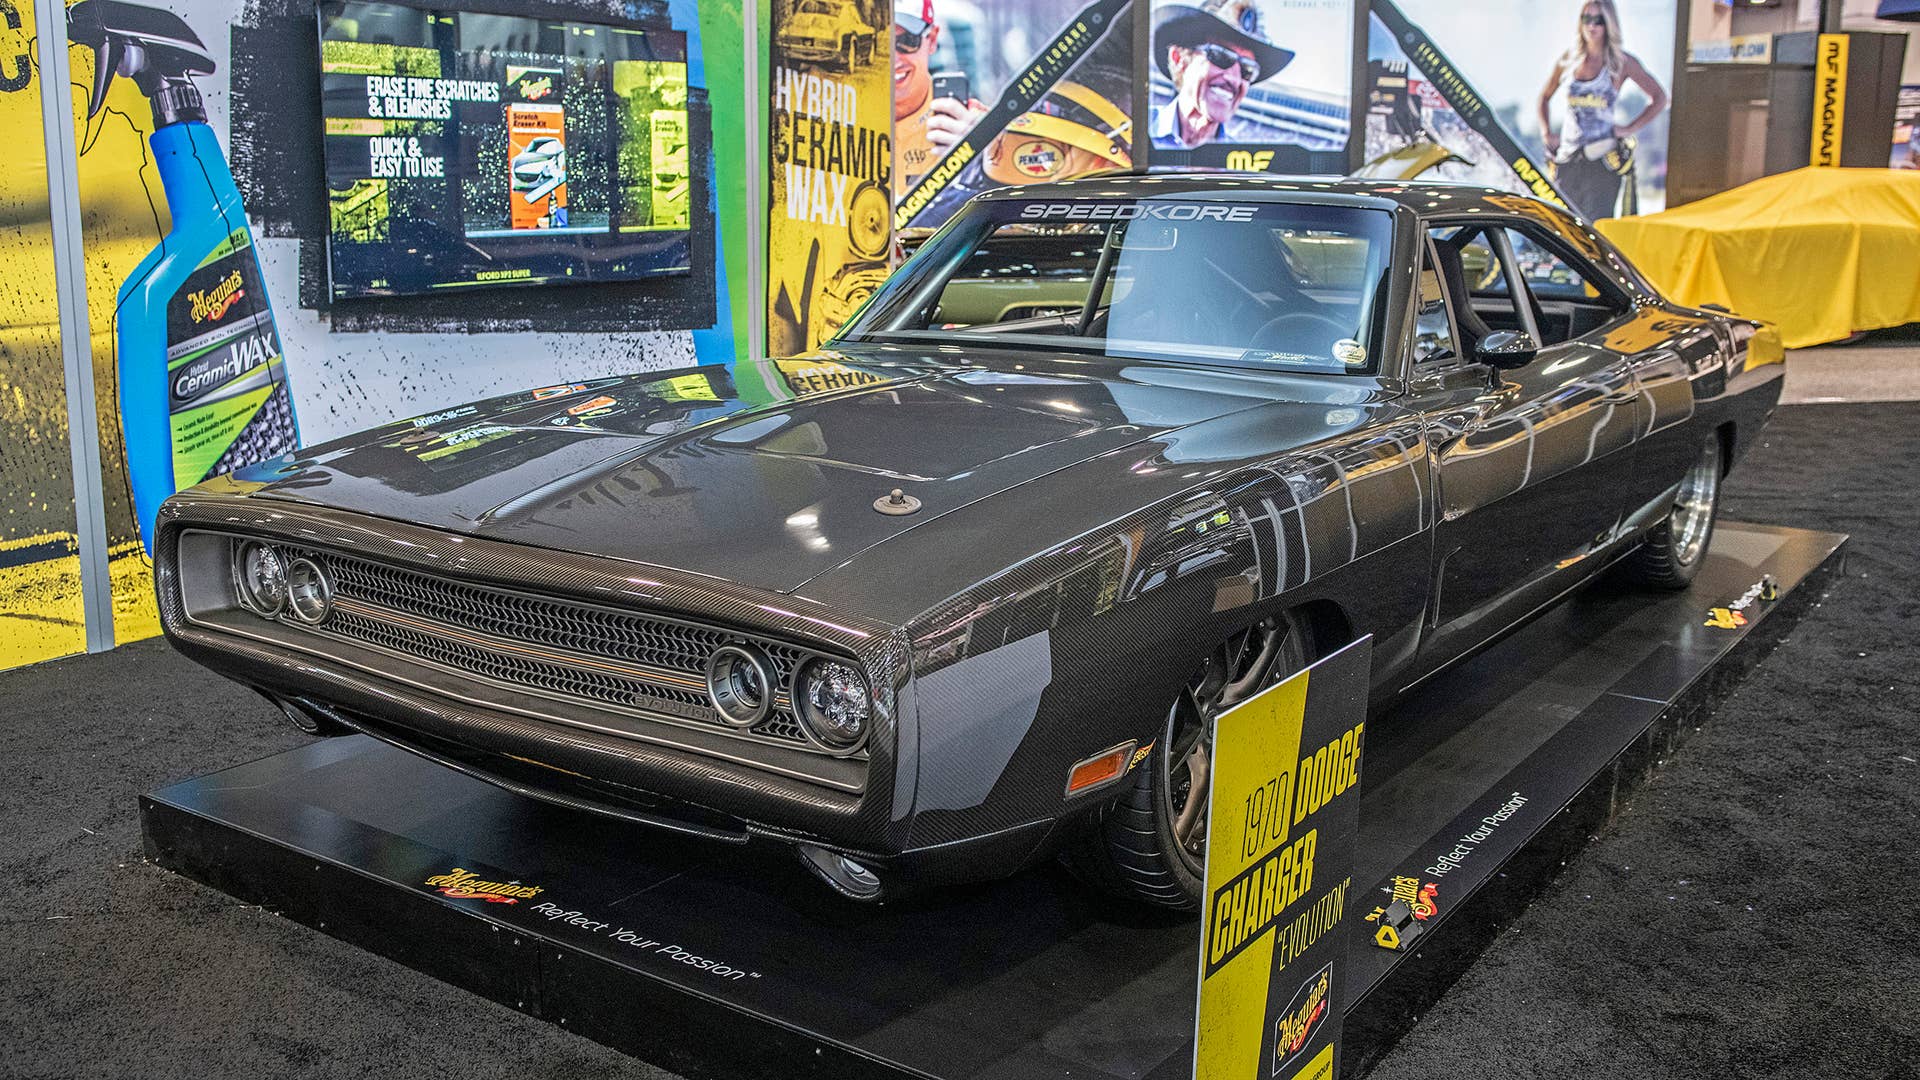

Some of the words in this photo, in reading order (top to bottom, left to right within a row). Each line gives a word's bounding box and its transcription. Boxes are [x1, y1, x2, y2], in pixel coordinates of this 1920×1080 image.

[1017, 64, 1045, 95] JOEY
[1045, 21, 1087, 65] LOGANO
[366, 76, 407, 98] ERASE
[407, 79, 435, 99] FINE
[435, 80, 500, 102] SCRATCHES
[368, 97, 384, 118] &
[385, 98, 451, 119] BLEMISHES
[776, 65, 857, 128] HYBRID
[369, 137, 407, 157] QUICK
[408, 137, 423, 158] &
[371, 157, 401, 178] EASY
[405, 157, 421, 178] TO
[422, 157, 445, 178] USE
[773, 106, 891, 186] CERAMIC
[785, 162, 847, 228] WAX
[1020, 204, 1259, 222] SPEEDKORE
[1241, 770, 1290, 864] 1970
[1293, 722, 1364, 826] DODGE
[1425, 843, 1474, 878] Reflect
[1460, 824, 1494, 844] Your
[1210, 828, 1318, 965] CHARGER
[530, 902, 610, 933] Reflect
[608, 927, 661, 949] Your
